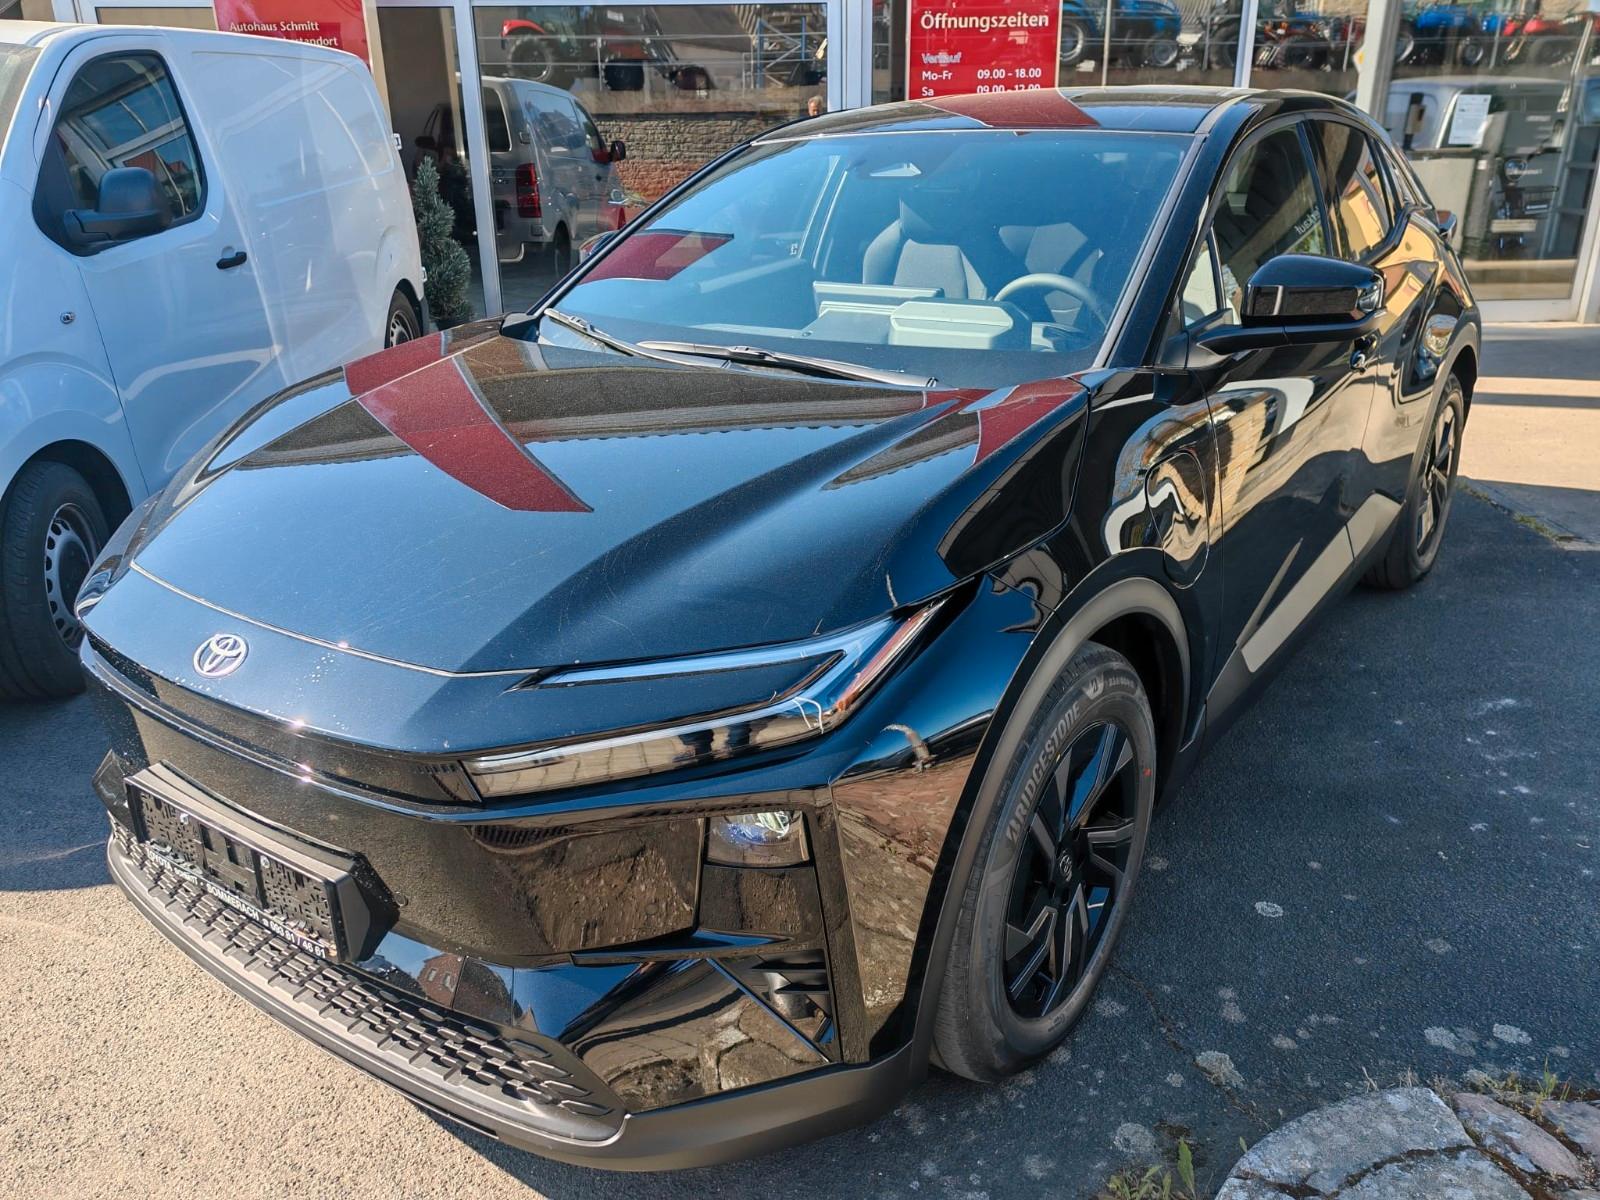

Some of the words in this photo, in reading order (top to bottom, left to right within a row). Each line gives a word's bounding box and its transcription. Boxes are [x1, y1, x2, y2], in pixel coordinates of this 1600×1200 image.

[229, 22, 278, 33] Autohaus
[279, 21, 320, 32] Schmitt
[920, 11, 1049, 32] Öffnungszeiten
[922, 70, 953, 80] Mo-Fr
[977, 69, 1006, 79] 09.00
[1015, 68, 1042, 78] 18.00
[921, 86, 934, 96] Sa
[1006, 701, 1081, 843] BRIDGESTONE
